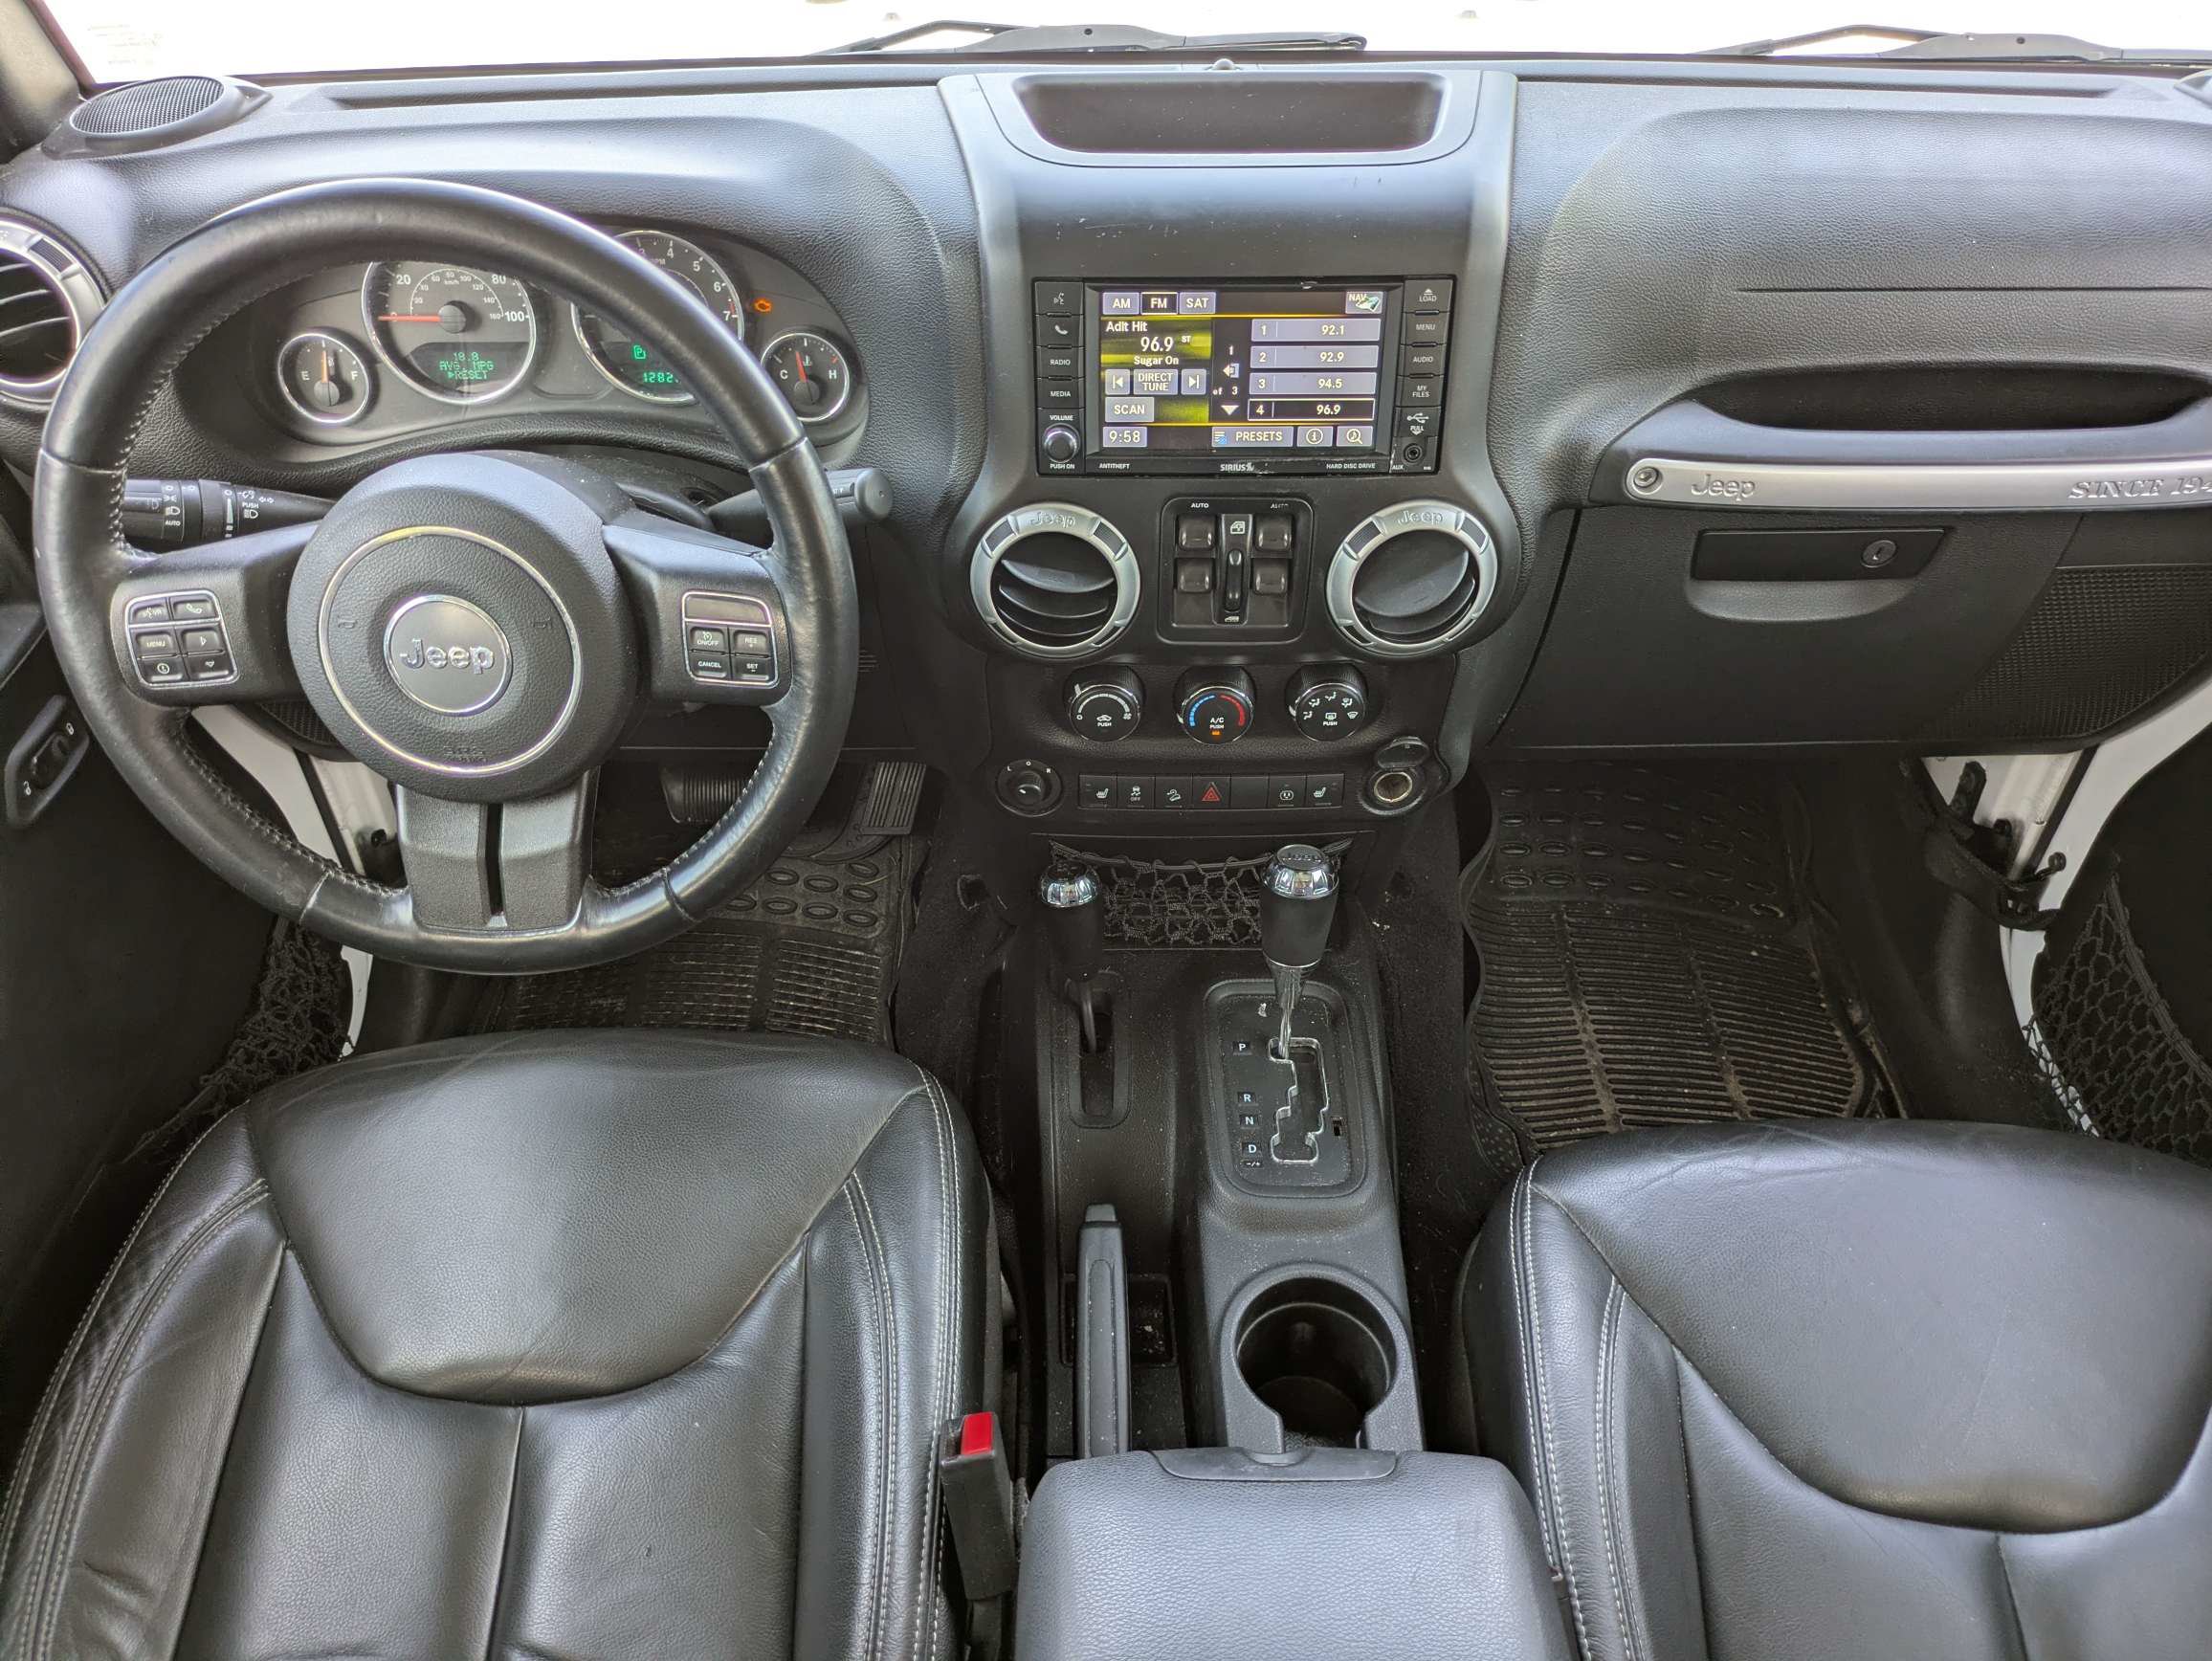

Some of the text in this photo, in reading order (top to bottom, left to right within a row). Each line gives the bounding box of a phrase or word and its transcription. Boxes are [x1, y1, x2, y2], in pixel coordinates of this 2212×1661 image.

[667, 248, 674, 258] 4
[693, 260, 701, 272] 5
[396, 274, 411, 285] 20
[492, 274, 506, 284] 80
[714, 281, 721, 292] 6
[1112, 297, 1132, 309] AM
[1150, 297, 1168, 309] FM
[1185, 297, 1208, 309] SAT
[1348, 294, 1367, 302] NAV
[505, 311, 526, 322] 100
[723, 310, 730, 321] 7
[1132, 321, 1148, 332] Hit
[1261, 325, 1268, 336] 1
[1321, 324, 1345, 336] 92.1
[1140, 336, 1174, 352] 96.9
[1228, 345, 1235, 356] 1
[1134, 355, 1180, 367] Sugar On
[1259, 351, 1267, 363] 2
[1319, 351, 1344, 363] 92.9
[301, 370, 310, 381] E
[351, 370, 358, 381] F
[780, 369, 788, 380] C
[829, 369, 838, 380] H
[1138, 372, 1174, 382] DIRECT
[1141, 382, 1169, 391] TUNE
[1257, 378, 1266, 389] 3
[1318, 378, 1343, 389] 94.5
[1231, 387, 1238, 395] 3
[1113, 404, 1146, 415] SCAN
[1256, 405, 1264, 415] 4
[1316, 405, 1341, 416] 96.9
[1109, 431, 1141, 444] 9:58
[1235, 431, 1284, 442] PRESETS
[1691, 474, 1756, 501] Jeep
[1397, 509, 1444, 526] Jeep
[400, 637, 496, 675] Jeep
[1238, 1043, 1246, 1052] P
[1243, 1094, 1251, 1102] R
[1245, 1116, 1253, 1124] N
[1248, 1144, 1256, 1153] D
